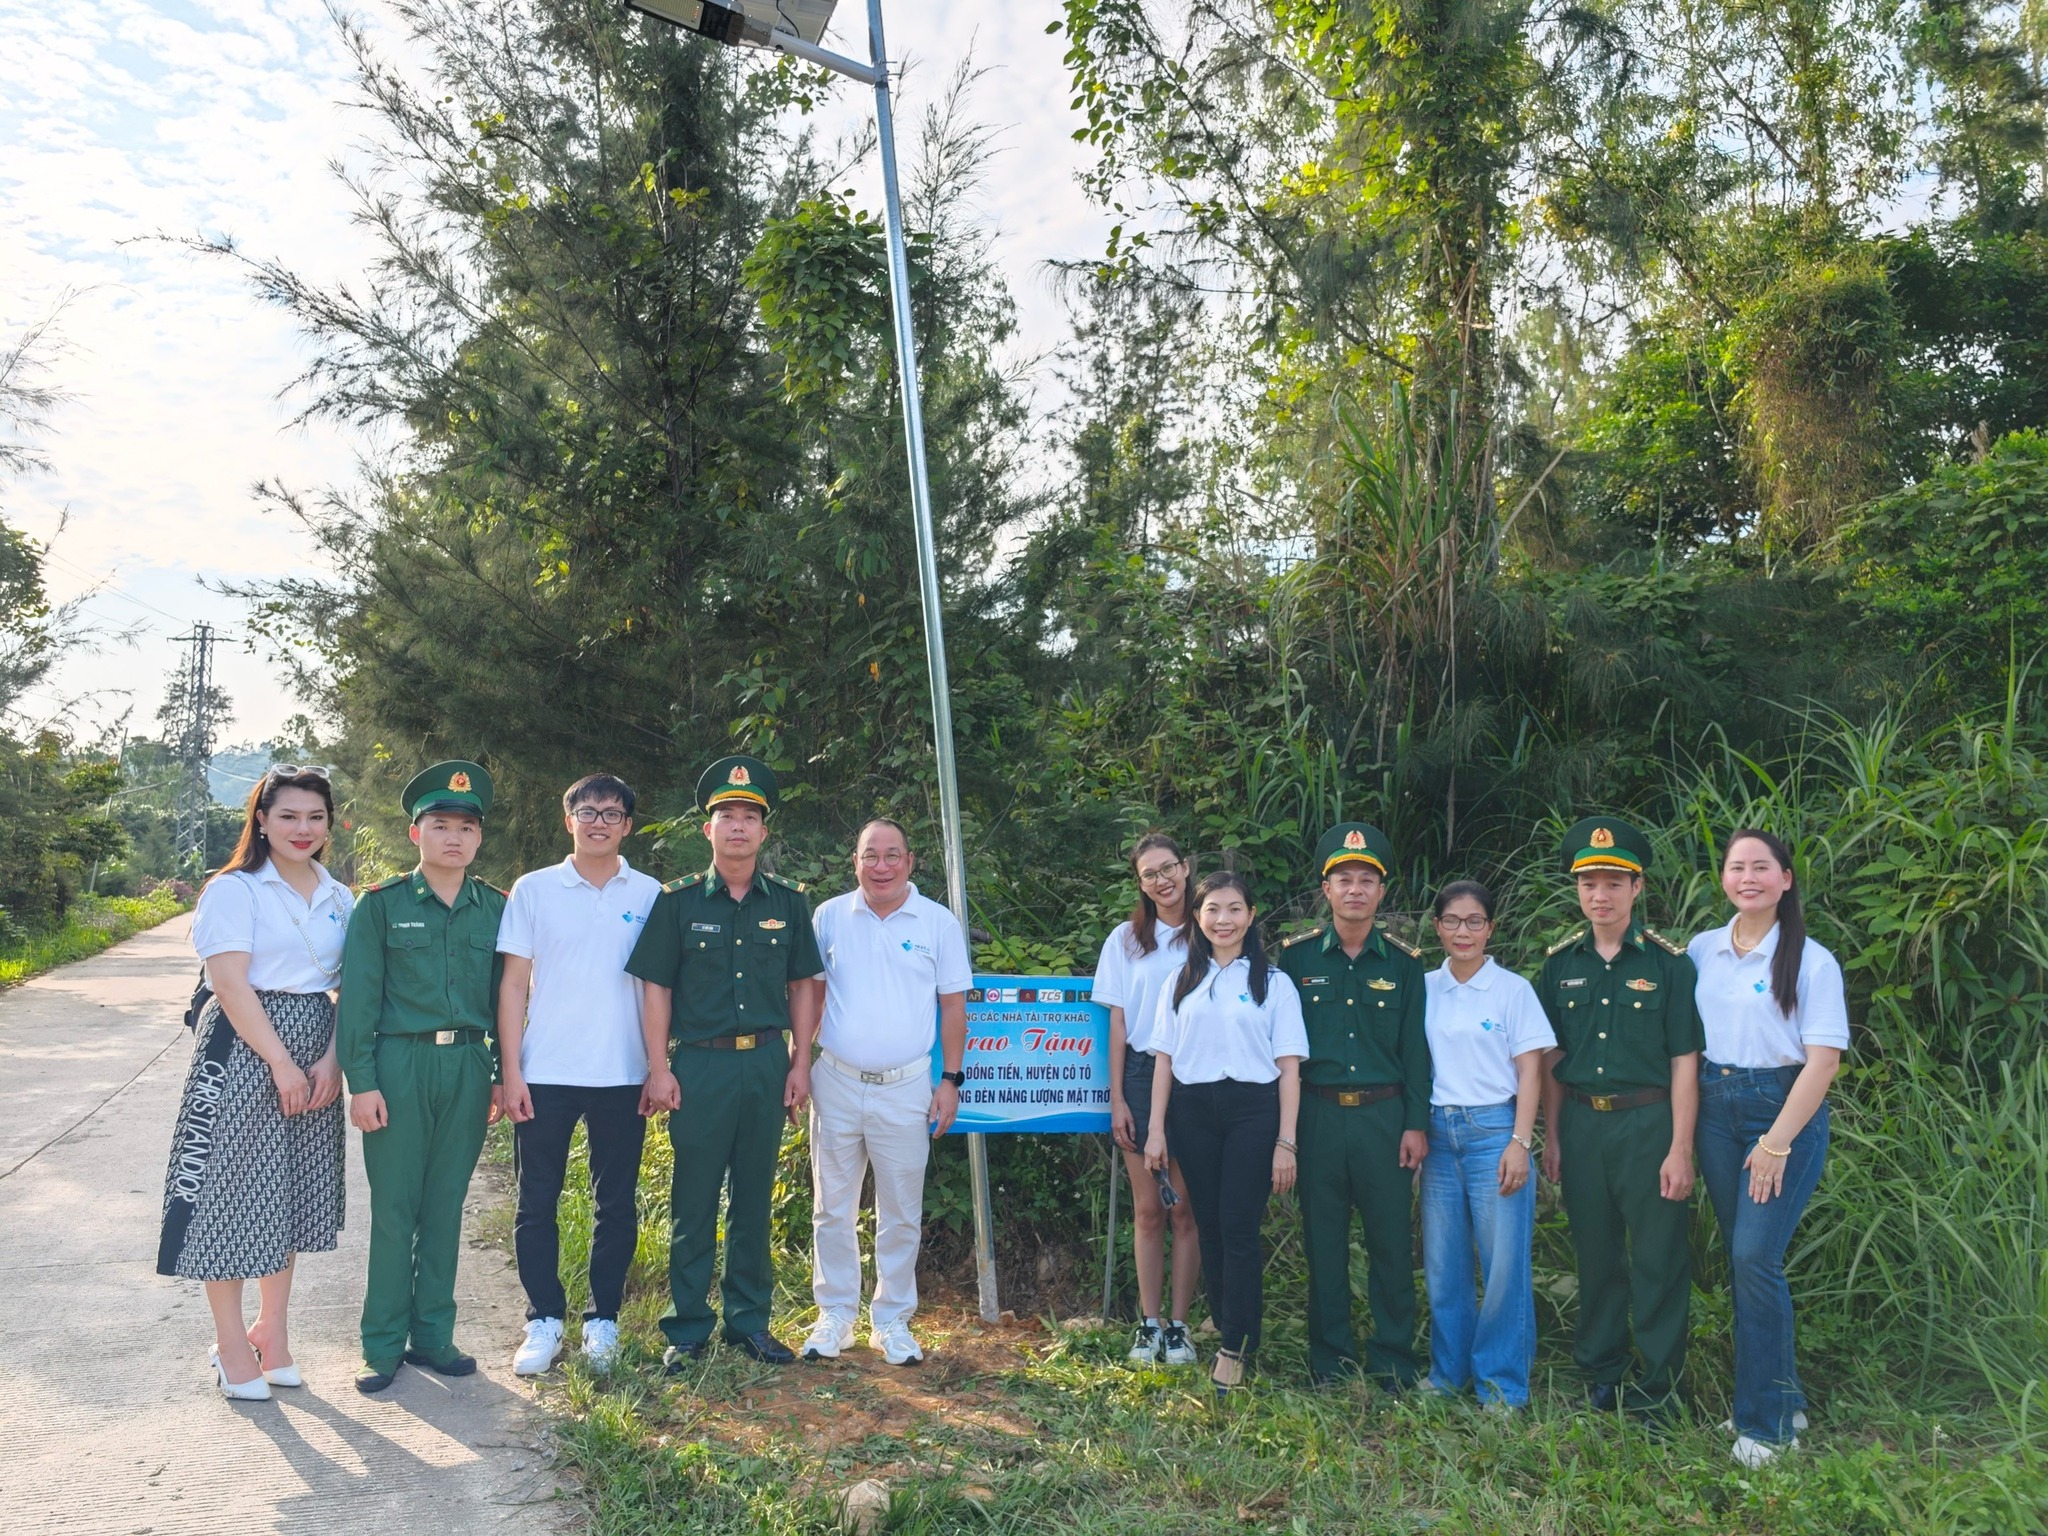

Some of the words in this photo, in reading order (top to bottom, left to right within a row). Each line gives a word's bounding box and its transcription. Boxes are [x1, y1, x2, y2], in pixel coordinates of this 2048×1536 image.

[1041, 991, 1061, 1001] TCS
[980, 1010, 1000, 1022] CÁC
[1002, 1010, 1021, 1022] NHÀ
[1025, 1010, 1040, 1022] TÀI
[1043, 1013, 1062, 1024] TRỢ
[1064, 1010, 1090, 1023] KHÁC
[1022, 1028, 1094, 1056] Tặng
[1026, 1064, 1060, 1082] HUYỆN
[1062, 1064, 1076, 1080] CÔ
[1080, 1064, 1091, 1080] TÔ
[975, 1087, 995, 1103] ĐÈN
[999, 1087, 1027, 1103] NĂNG
[1030, 1089, 1064, 1106] LƯỢNG
[1066, 1087, 1088, 1106] MẶT
